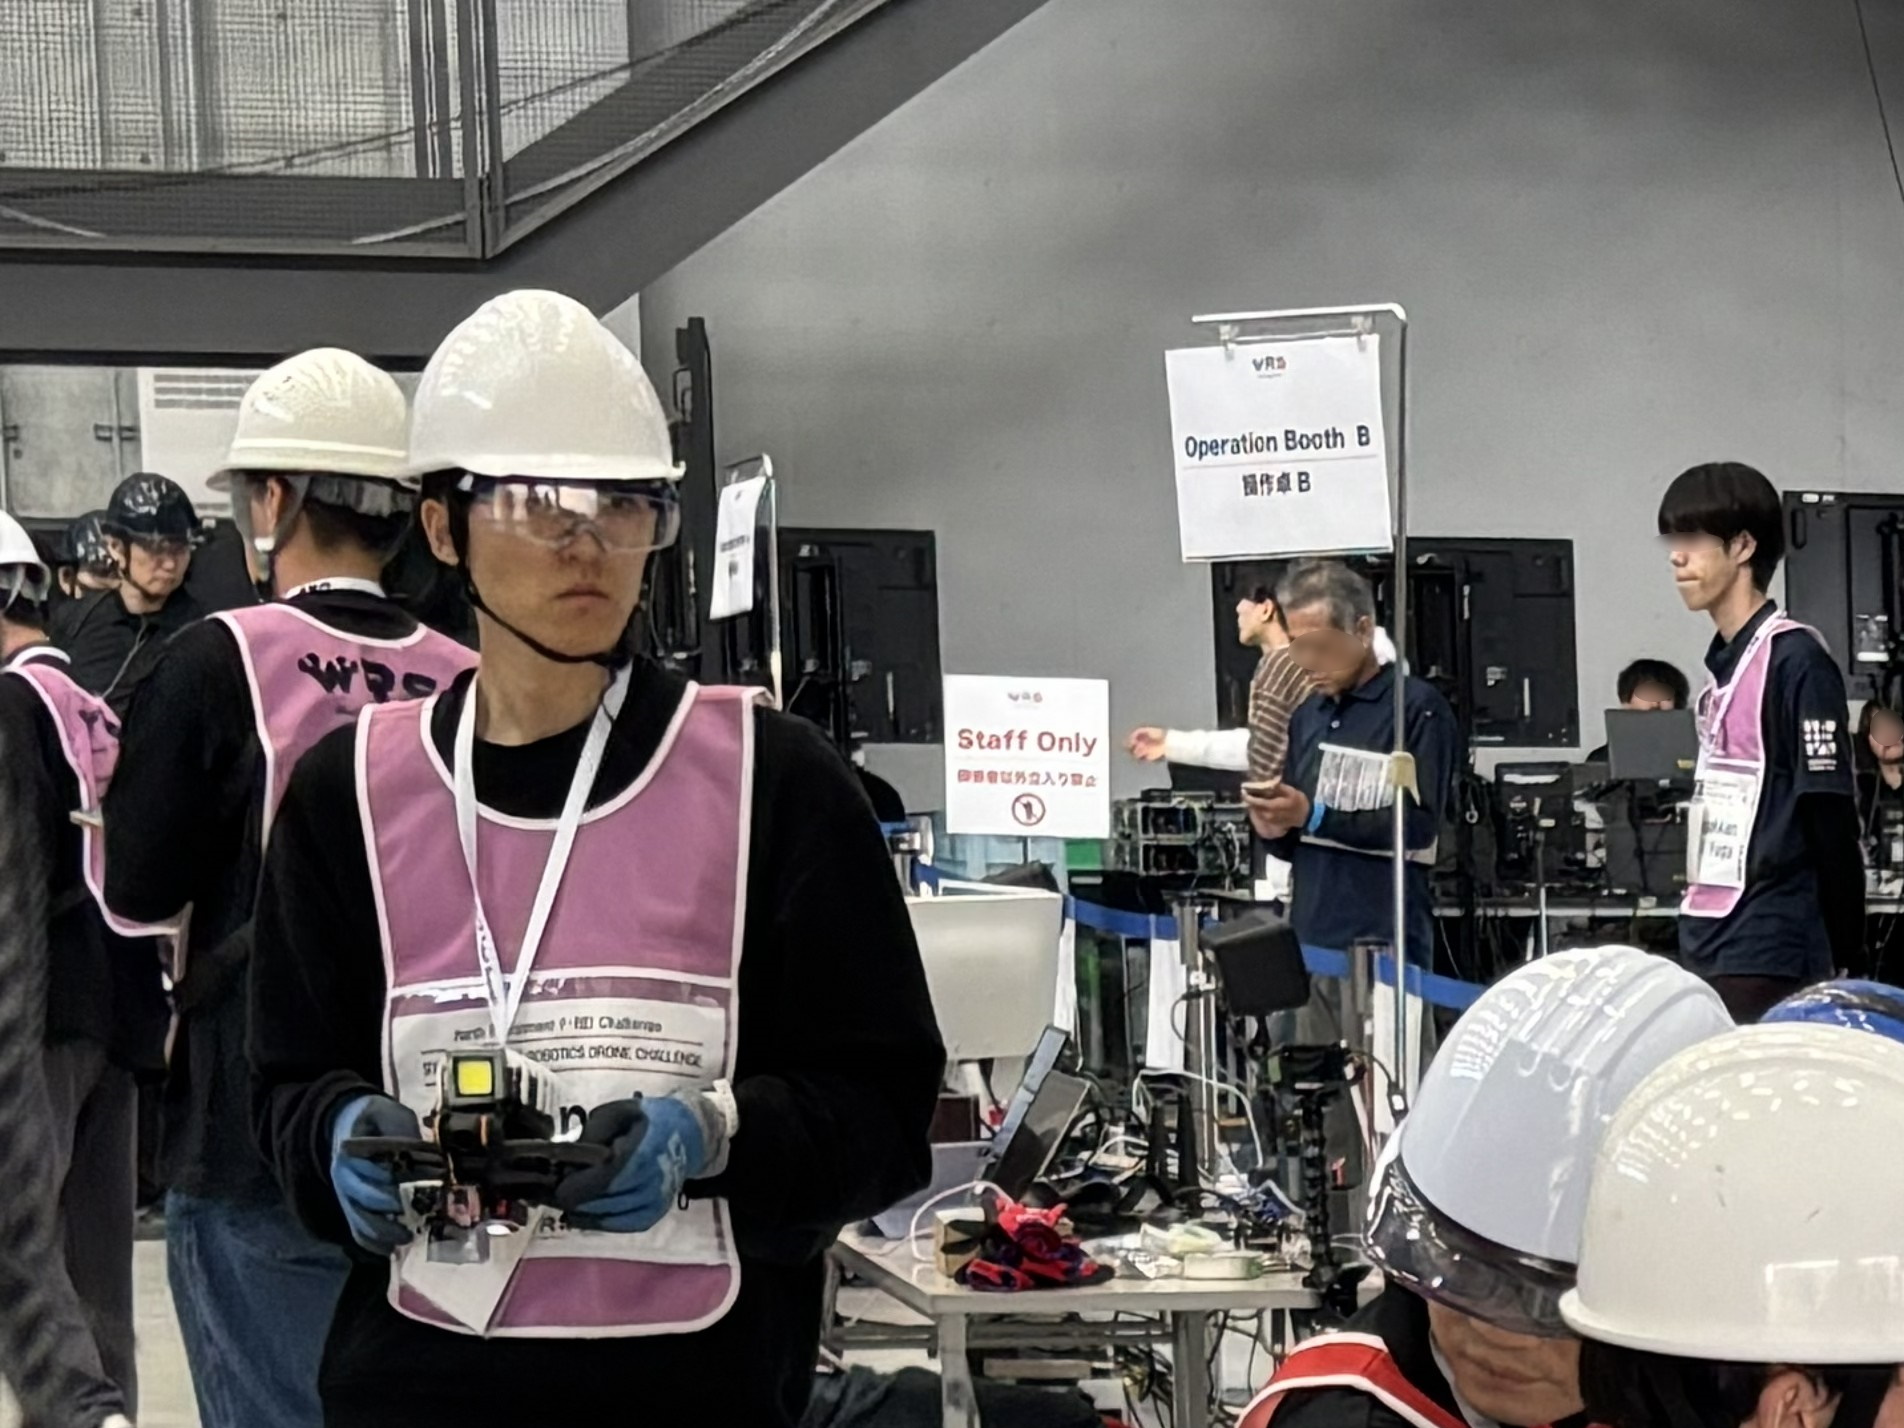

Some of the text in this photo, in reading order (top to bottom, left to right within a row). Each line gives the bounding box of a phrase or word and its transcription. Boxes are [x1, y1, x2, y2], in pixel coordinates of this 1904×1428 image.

[1185, 424, 1372, 461] Operation Booth B
[958, 728, 1098, 758] Staff Only
